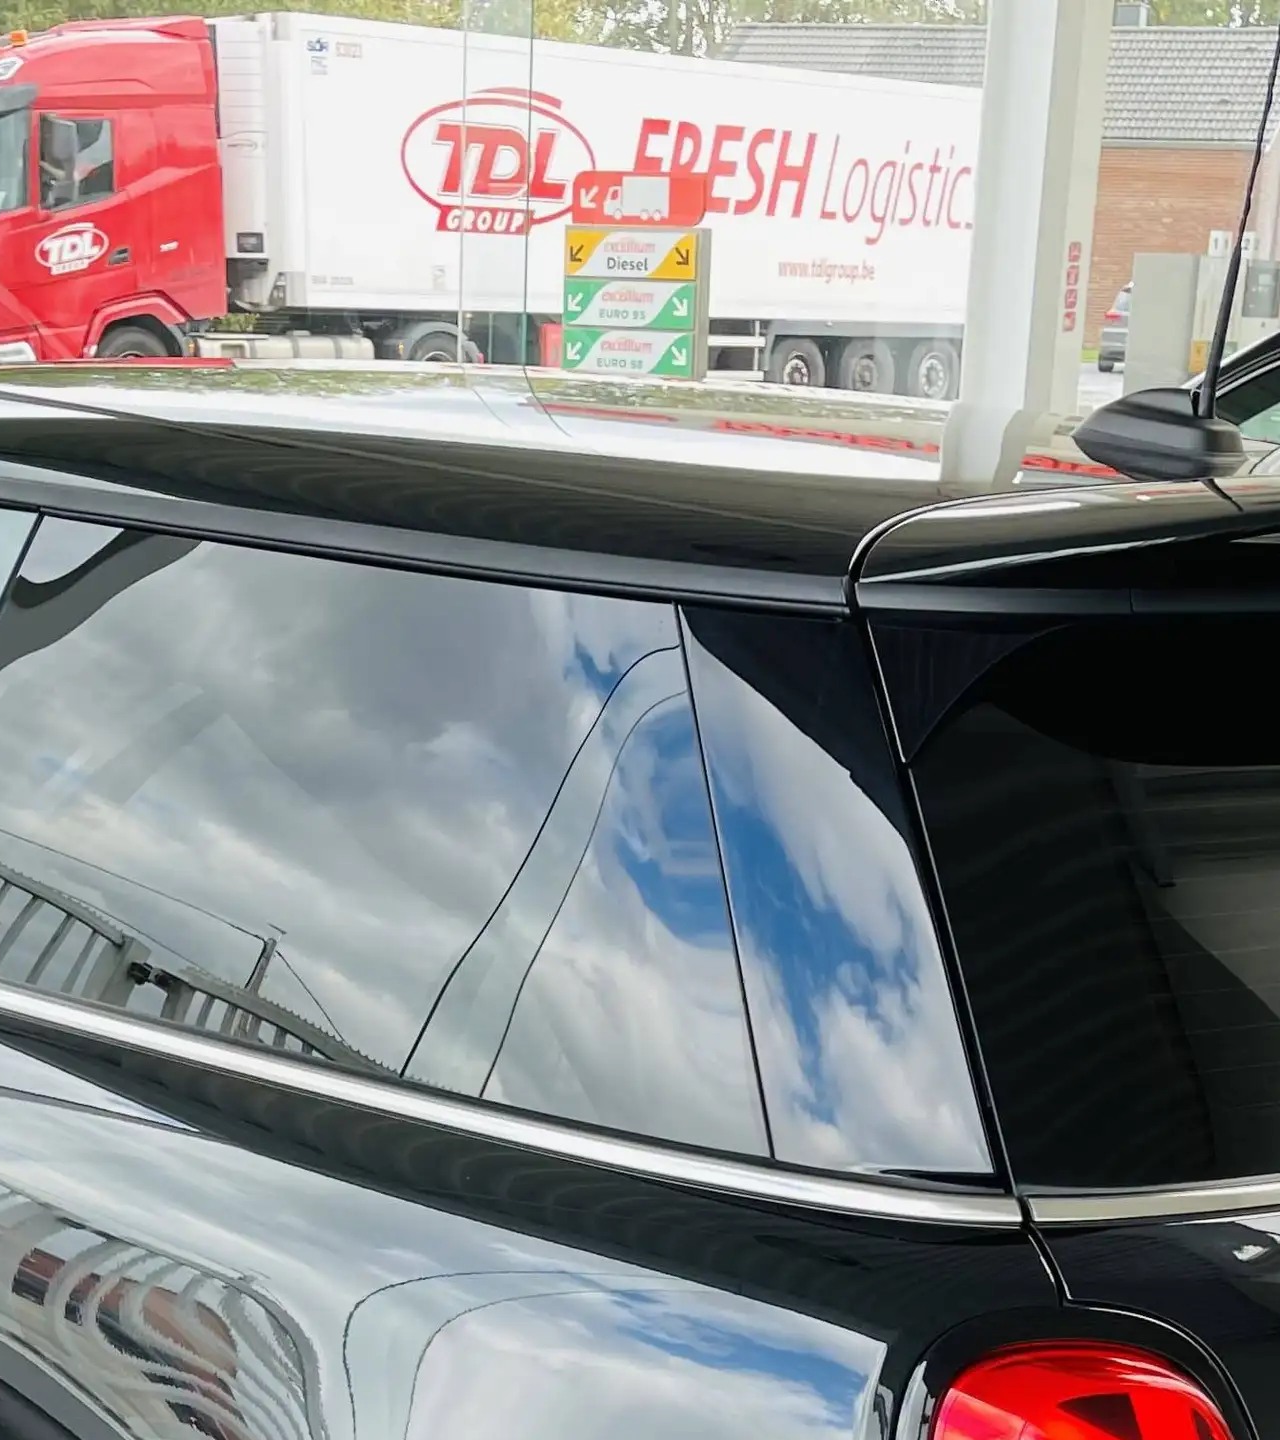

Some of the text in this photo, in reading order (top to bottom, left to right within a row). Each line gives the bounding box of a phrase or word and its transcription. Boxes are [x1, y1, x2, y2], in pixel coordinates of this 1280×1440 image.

[432, 119, 572, 203] TDL
[632, 117, 972, 245] FRESH Logistic
[446, 209, 528, 232] GROUP
[43, 232, 101, 264] TDL
[607, 256, 648, 271] Diesel
[599, 308, 629, 319] EURO
[597, 358, 627, 369] EURO
